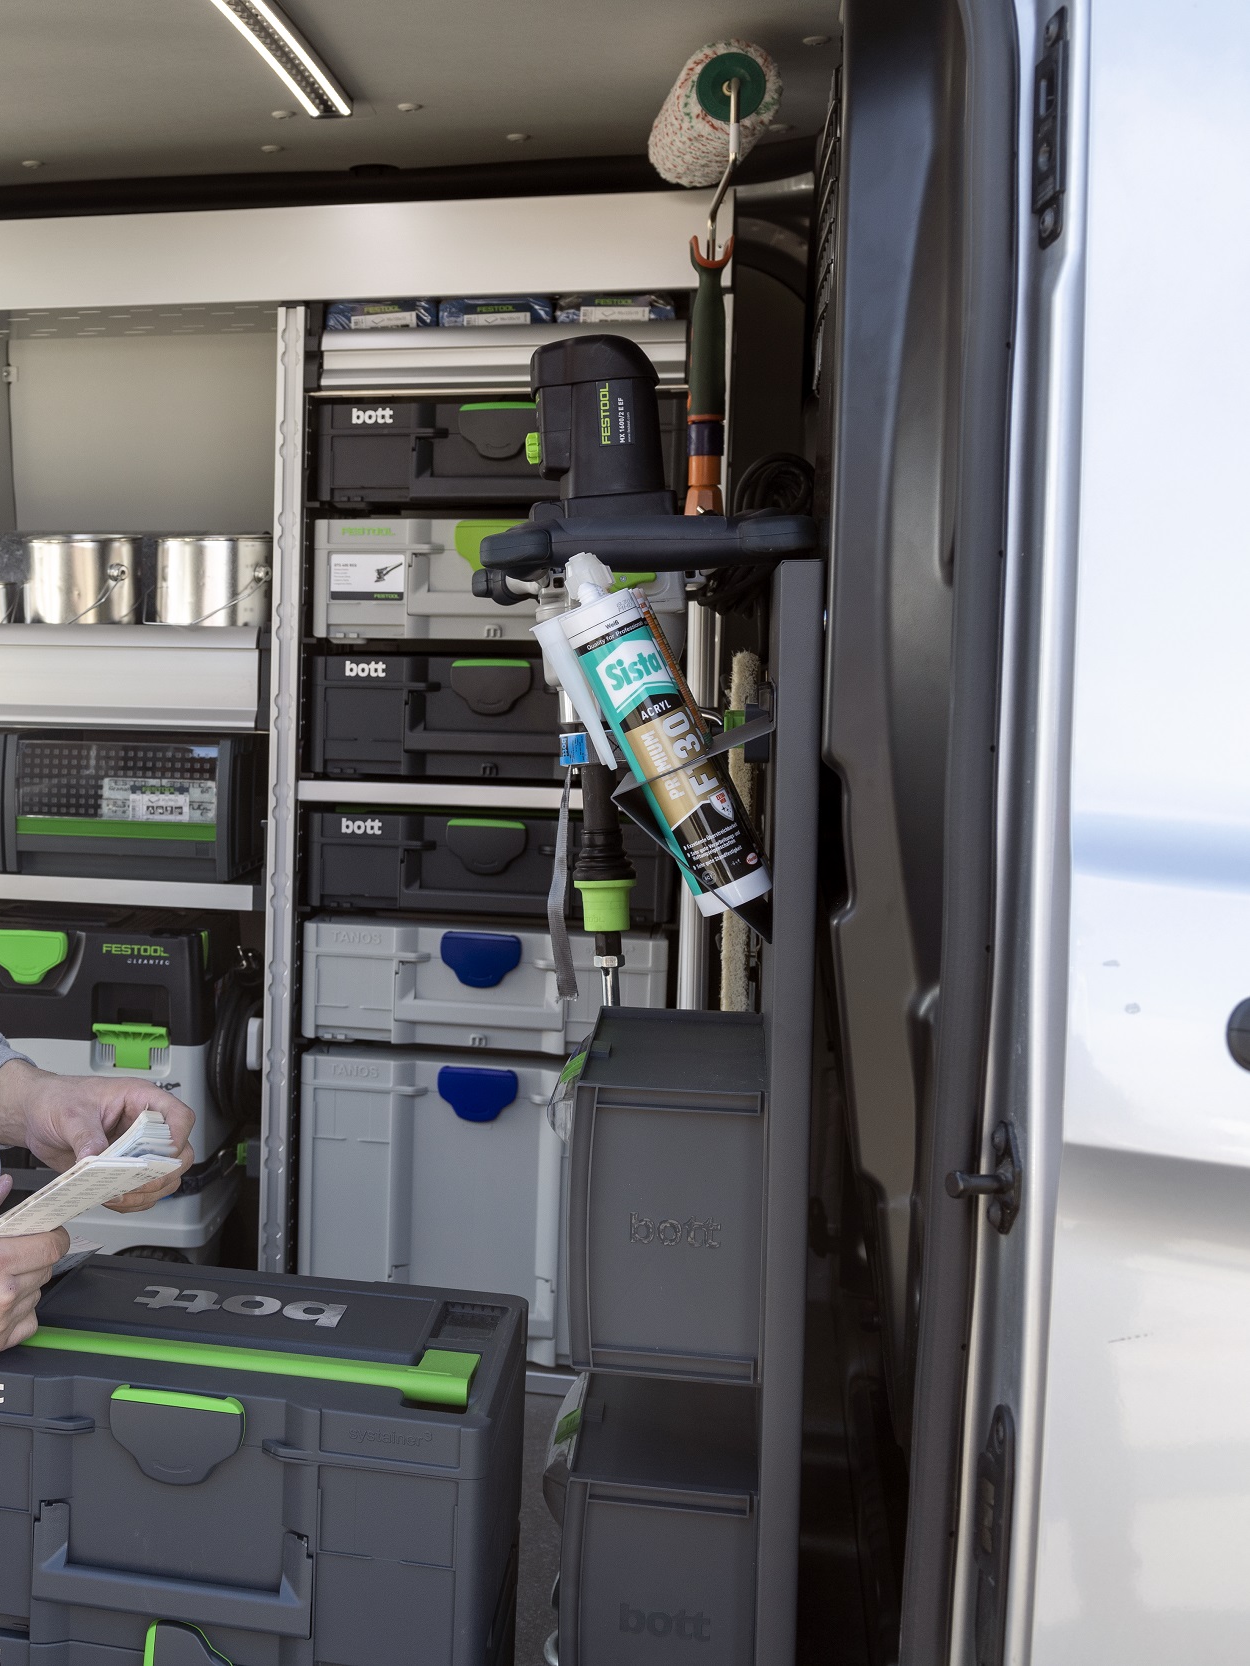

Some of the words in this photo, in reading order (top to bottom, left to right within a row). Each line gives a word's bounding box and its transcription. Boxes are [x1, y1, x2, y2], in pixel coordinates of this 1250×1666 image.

[617, 397, 623, 405] EF
[352, 407, 394, 425] bott
[600, 382, 611, 445] FESTOOL
[619, 433, 625, 443] MX
[605, 619, 619, 629] Weiß
[586, 638, 606, 651] Quality
[605, 633, 615, 641] for
[345, 660, 386, 677] bott
[605, 652, 662, 691] Sista
[641, 700, 672, 720] ACRYL
[341, 817, 382, 834] bott
[102, 944, 169, 956] FESTOOL
[627, 1211, 721, 1248] bott
[134, 1286, 348, 1327] bott
[619, 1602, 710, 1642] bott
